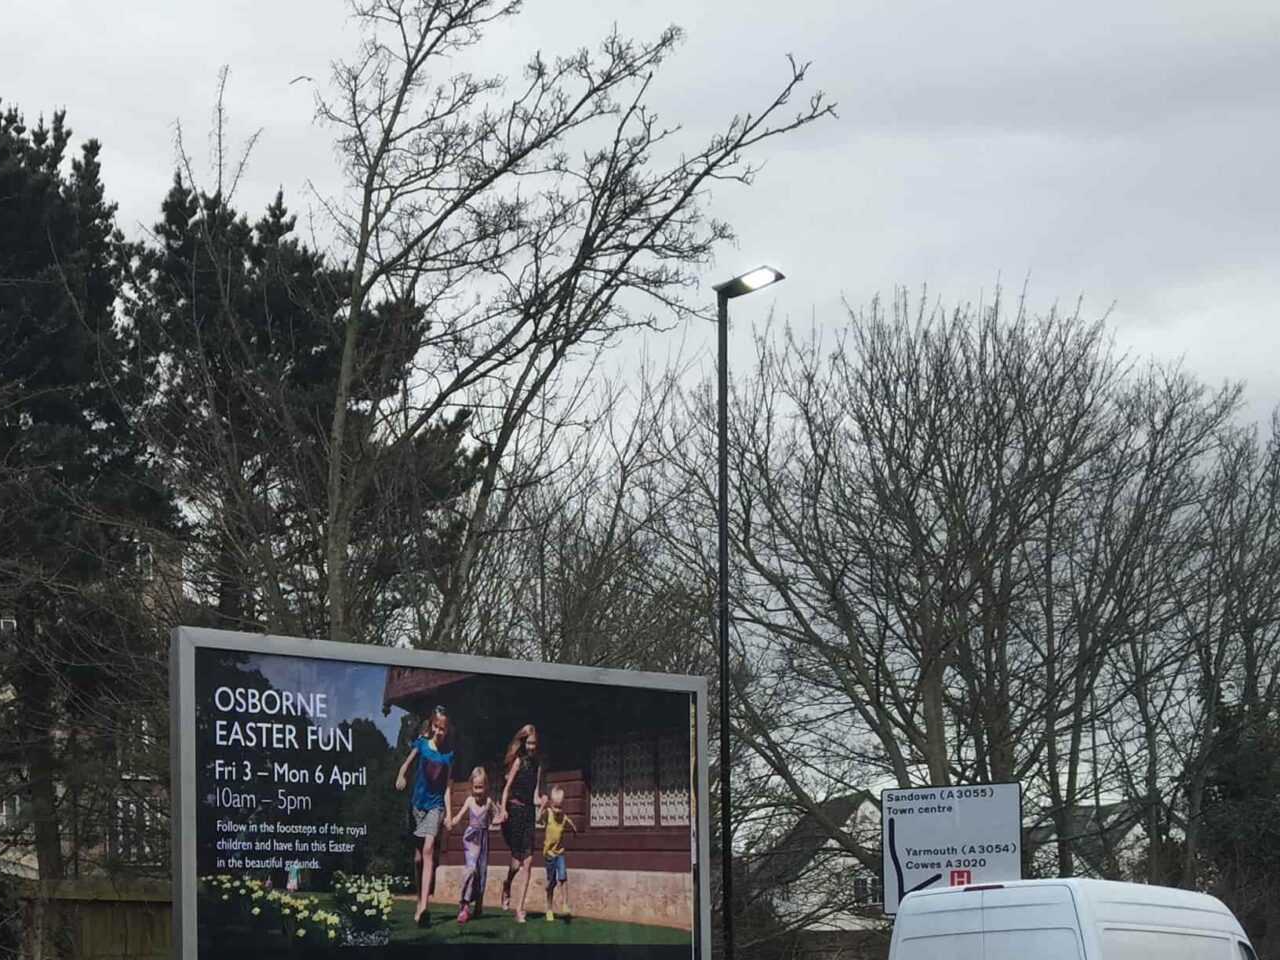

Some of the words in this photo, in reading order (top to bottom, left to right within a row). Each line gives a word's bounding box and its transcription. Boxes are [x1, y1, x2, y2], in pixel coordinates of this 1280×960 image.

[215, 686, 327, 718] OSBORNE
[215, 720, 299, 749] EASTER
[307, 726, 353, 752] FUN
[215, 760, 236, 780] Fri
[242, 761, 252, 781] 3
[274, 763, 309, 784] Mon
[314, 765, 325, 784] 6
[329, 765, 367, 791] April
[215, 787, 256, 808] 10am
[278, 789, 312, 815] 5pm
[886, 792, 936, 803] Sandown
[940, 787, 994, 801] (A3055)
[886, 806, 915, 815] Town
[918, 804, 953, 814] centre
[216, 820, 246, 832] Follow
[249, 821, 258, 833] in
[260, 822, 275, 833] the
[277, 822, 317, 836] footsteps
[319, 823, 328, 834] of
[330, 823, 344, 835] the
[346, 824, 367, 838] royal
[216, 838, 252, 850] children
[255, 839, 271, 851] and
[274, 839, 293, 851] have
[295, 839, 309, 852] fun
[311, 840, 326, 852] this
[328, 840, 355, 853] Easter
[905, 847, 957, 857] Yarmouth
[962, 843, 1017, 855] (A3054)
[216, 857, 226, 868] in
[228, 857, 243, 868] the
[245, 857, 283, 869] beautiful
[905, 860, 942, 870] Cowes
[945, 858, 986, 868] A3020
